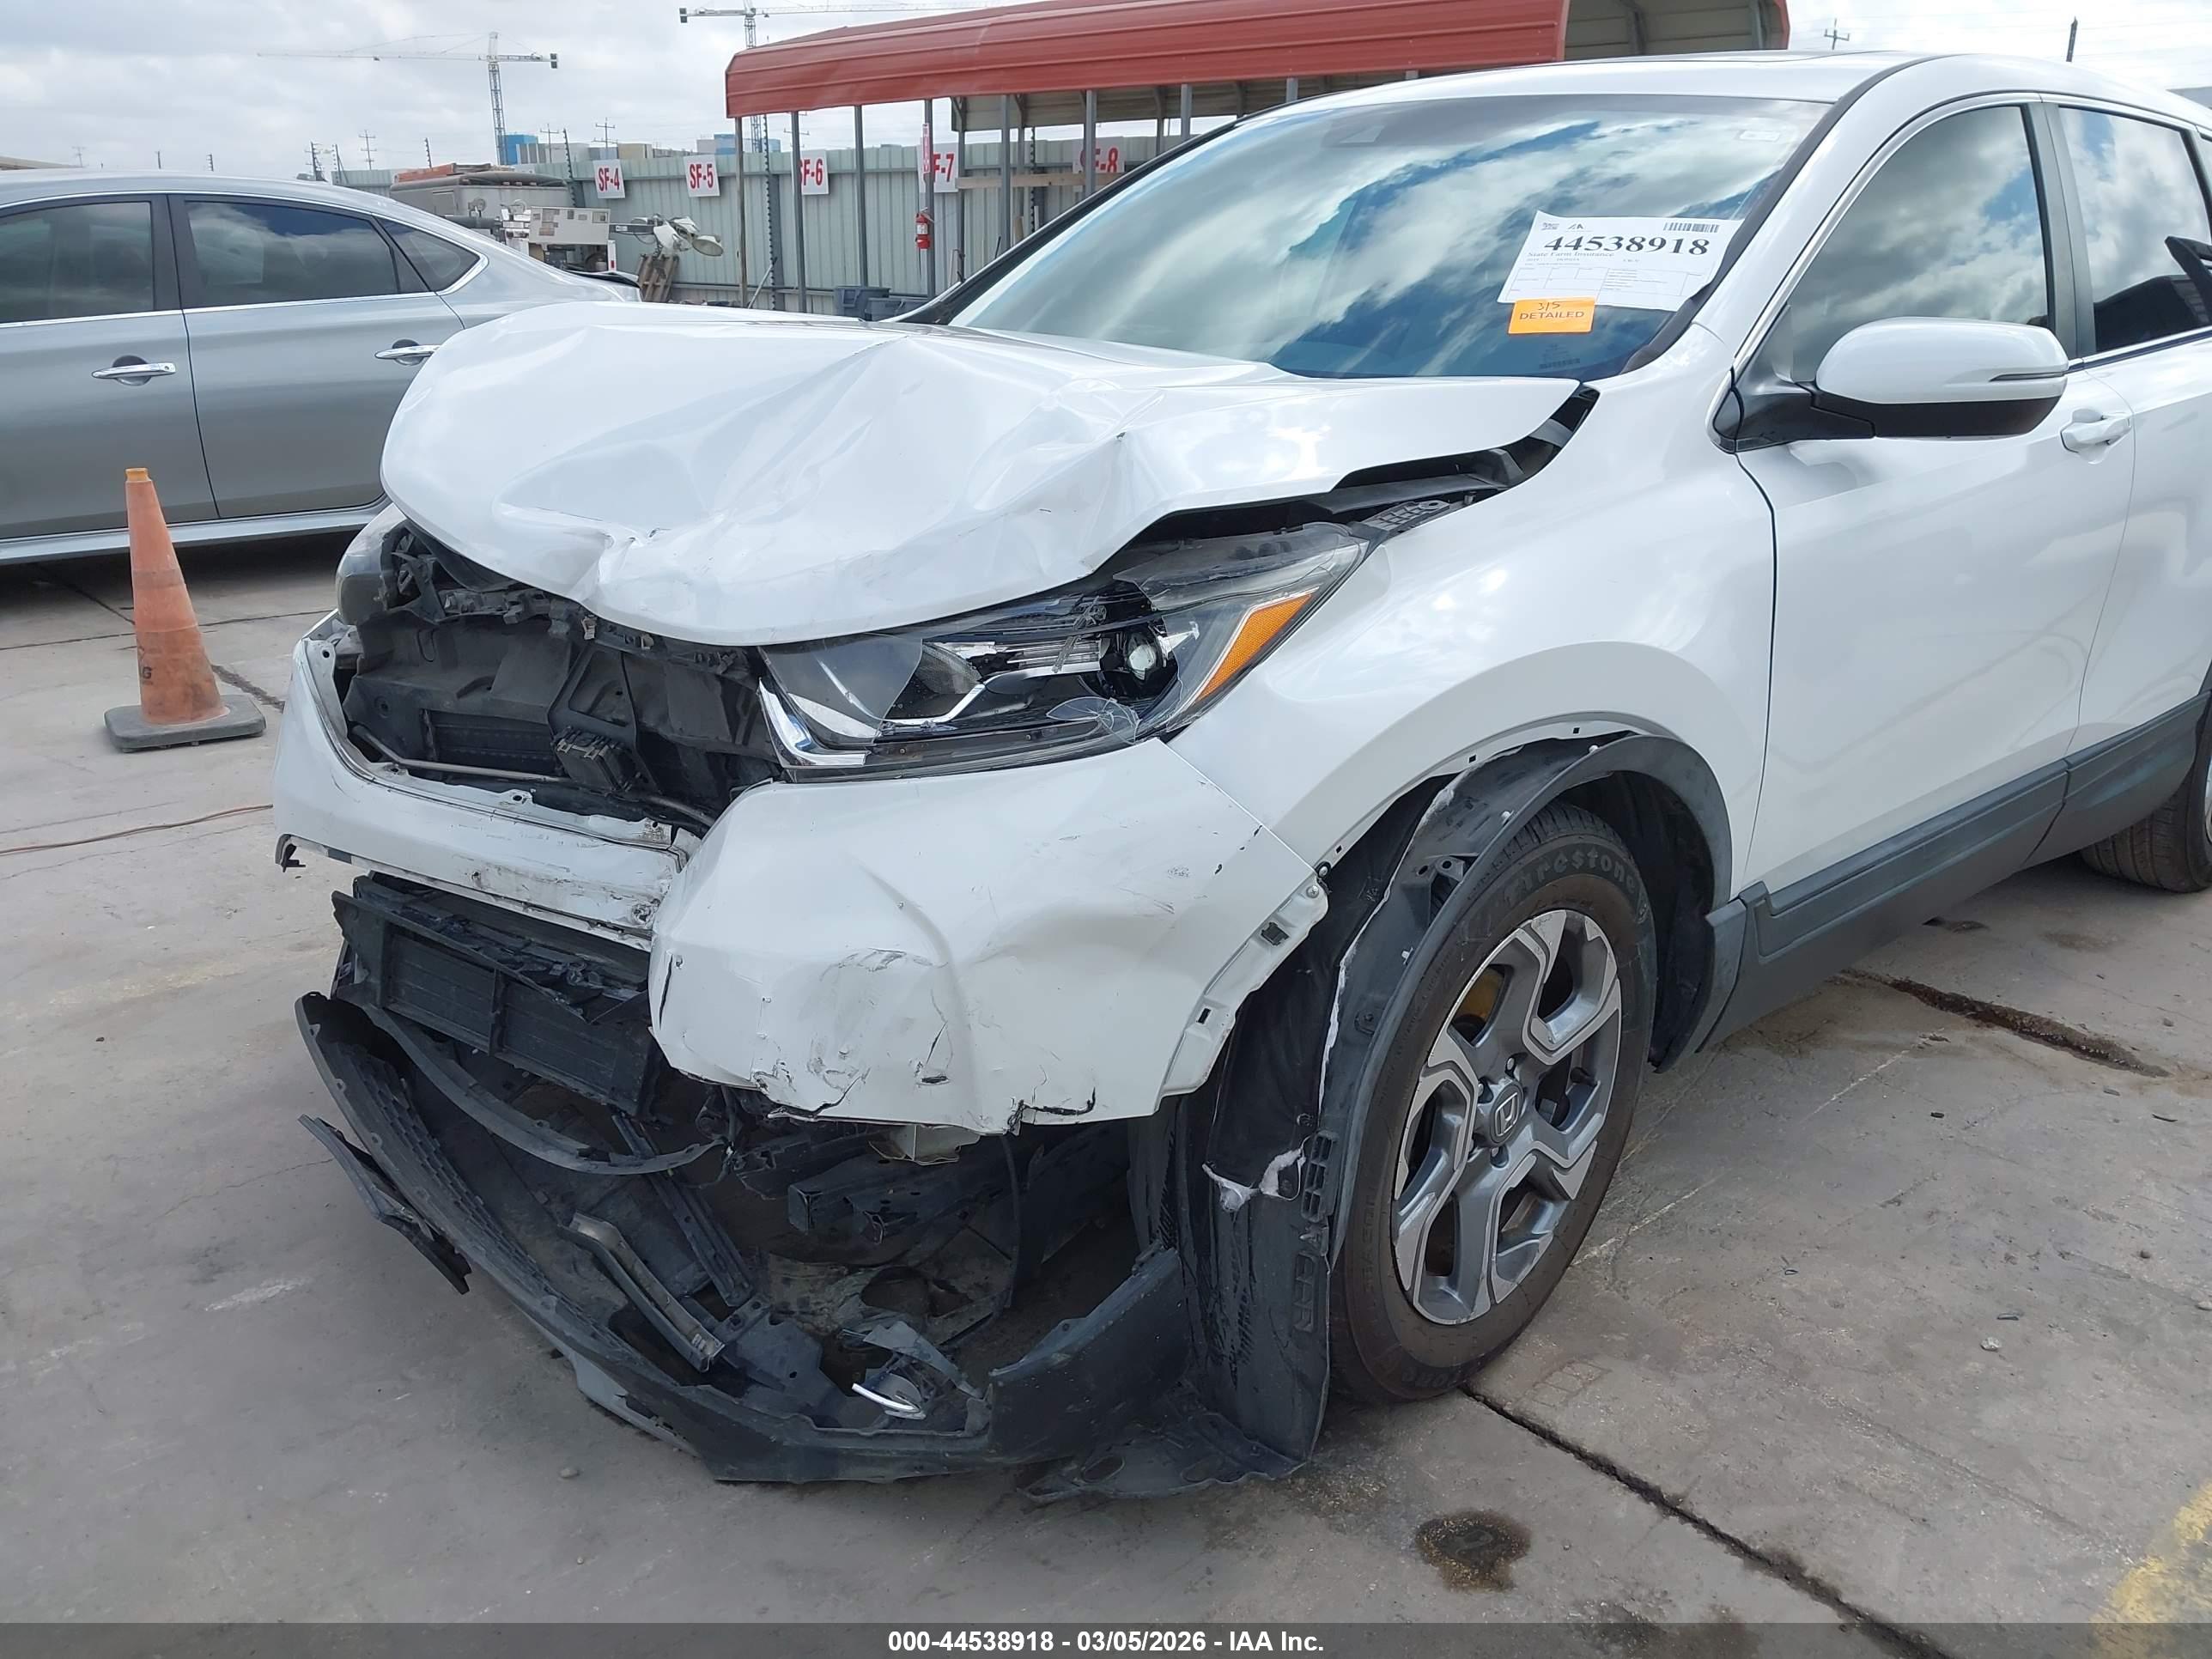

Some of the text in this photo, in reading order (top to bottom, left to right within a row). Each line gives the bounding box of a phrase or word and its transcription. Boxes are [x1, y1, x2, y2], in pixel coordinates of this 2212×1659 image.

[690, 163, 714, 189] SF-5
[933, 153, 954, 182] F-7
[598, 167, 620, 191] SF-4
[1544, 236, 1710, 255] 44538918
[1519, 311, 1584, 320] DETAILED
[1538, 301, 1560, 311] 3/5
